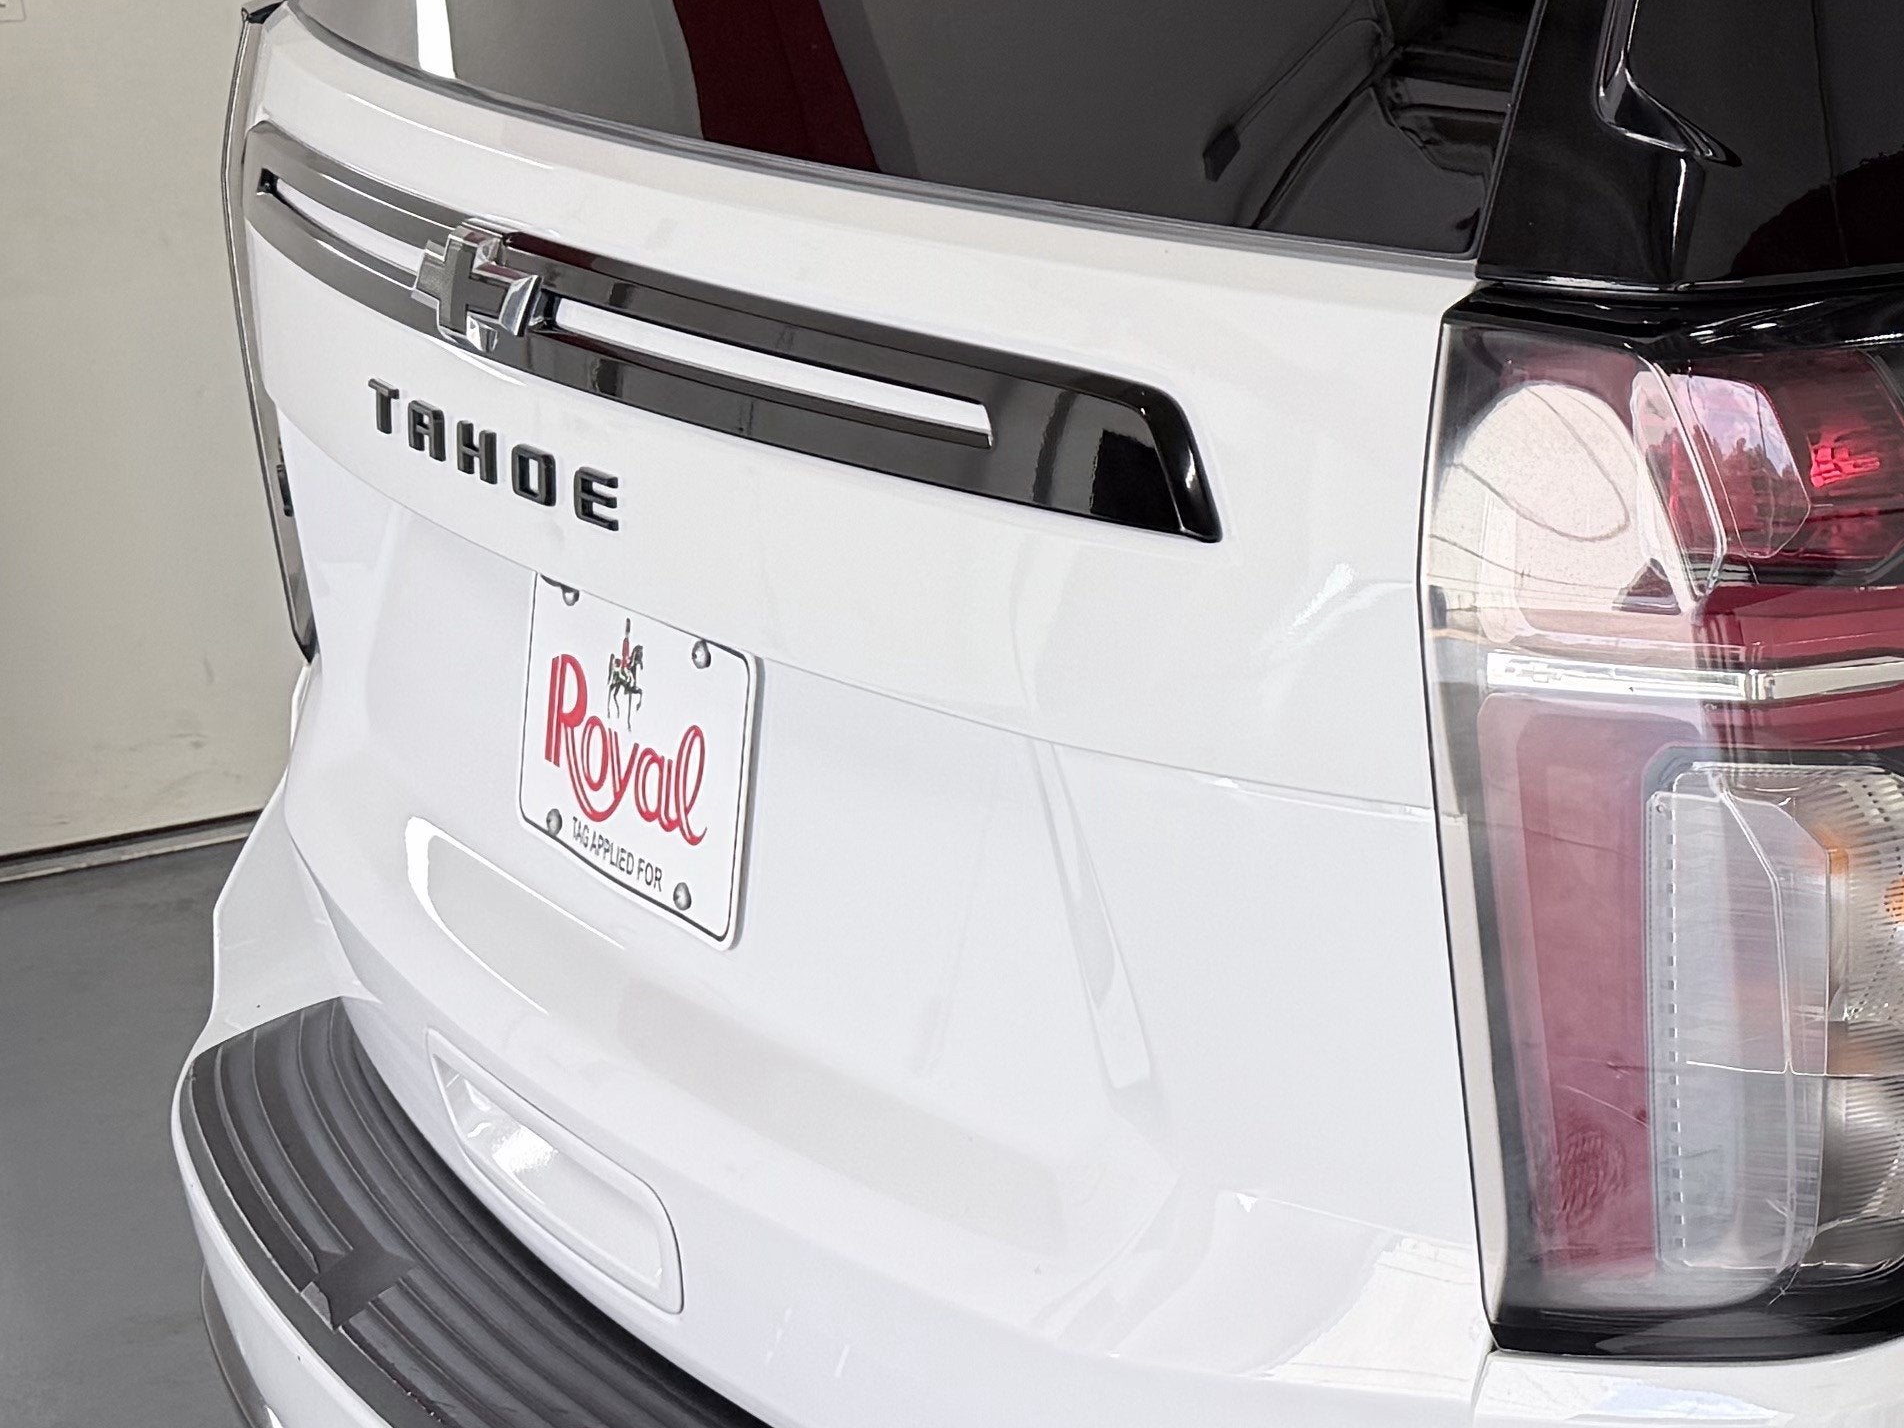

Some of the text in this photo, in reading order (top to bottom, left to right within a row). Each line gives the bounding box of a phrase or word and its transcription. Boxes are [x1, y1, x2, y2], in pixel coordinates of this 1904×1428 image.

[368, 378, 619, 532] TAHOE
[544, 653, 707, 846] Royal
[573, 816, 662, 892] TAG APPLIED FOR
